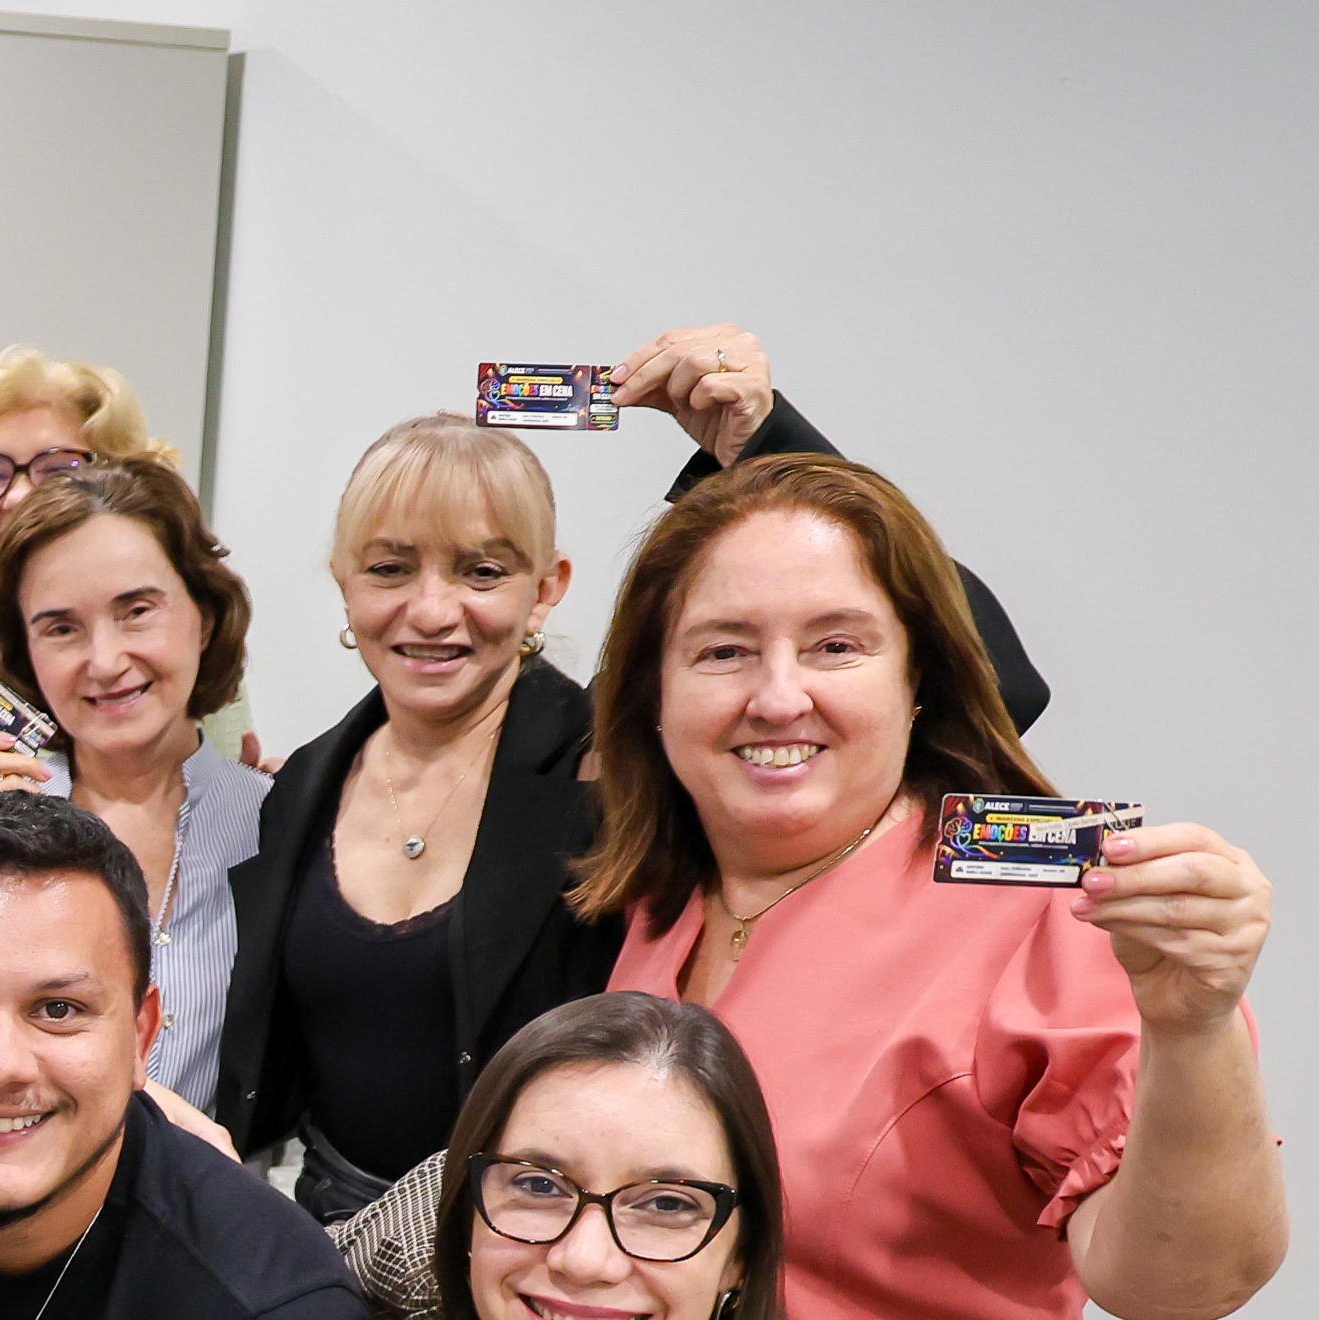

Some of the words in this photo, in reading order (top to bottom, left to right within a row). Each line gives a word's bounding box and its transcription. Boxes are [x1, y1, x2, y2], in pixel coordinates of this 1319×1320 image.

[539, 384, 552, 396] EM
[552, 385, 573, 397] CENA
[984, 802, 1010, 811] ALECE
[973, 823, 1027, 844] EMOÇÕES
